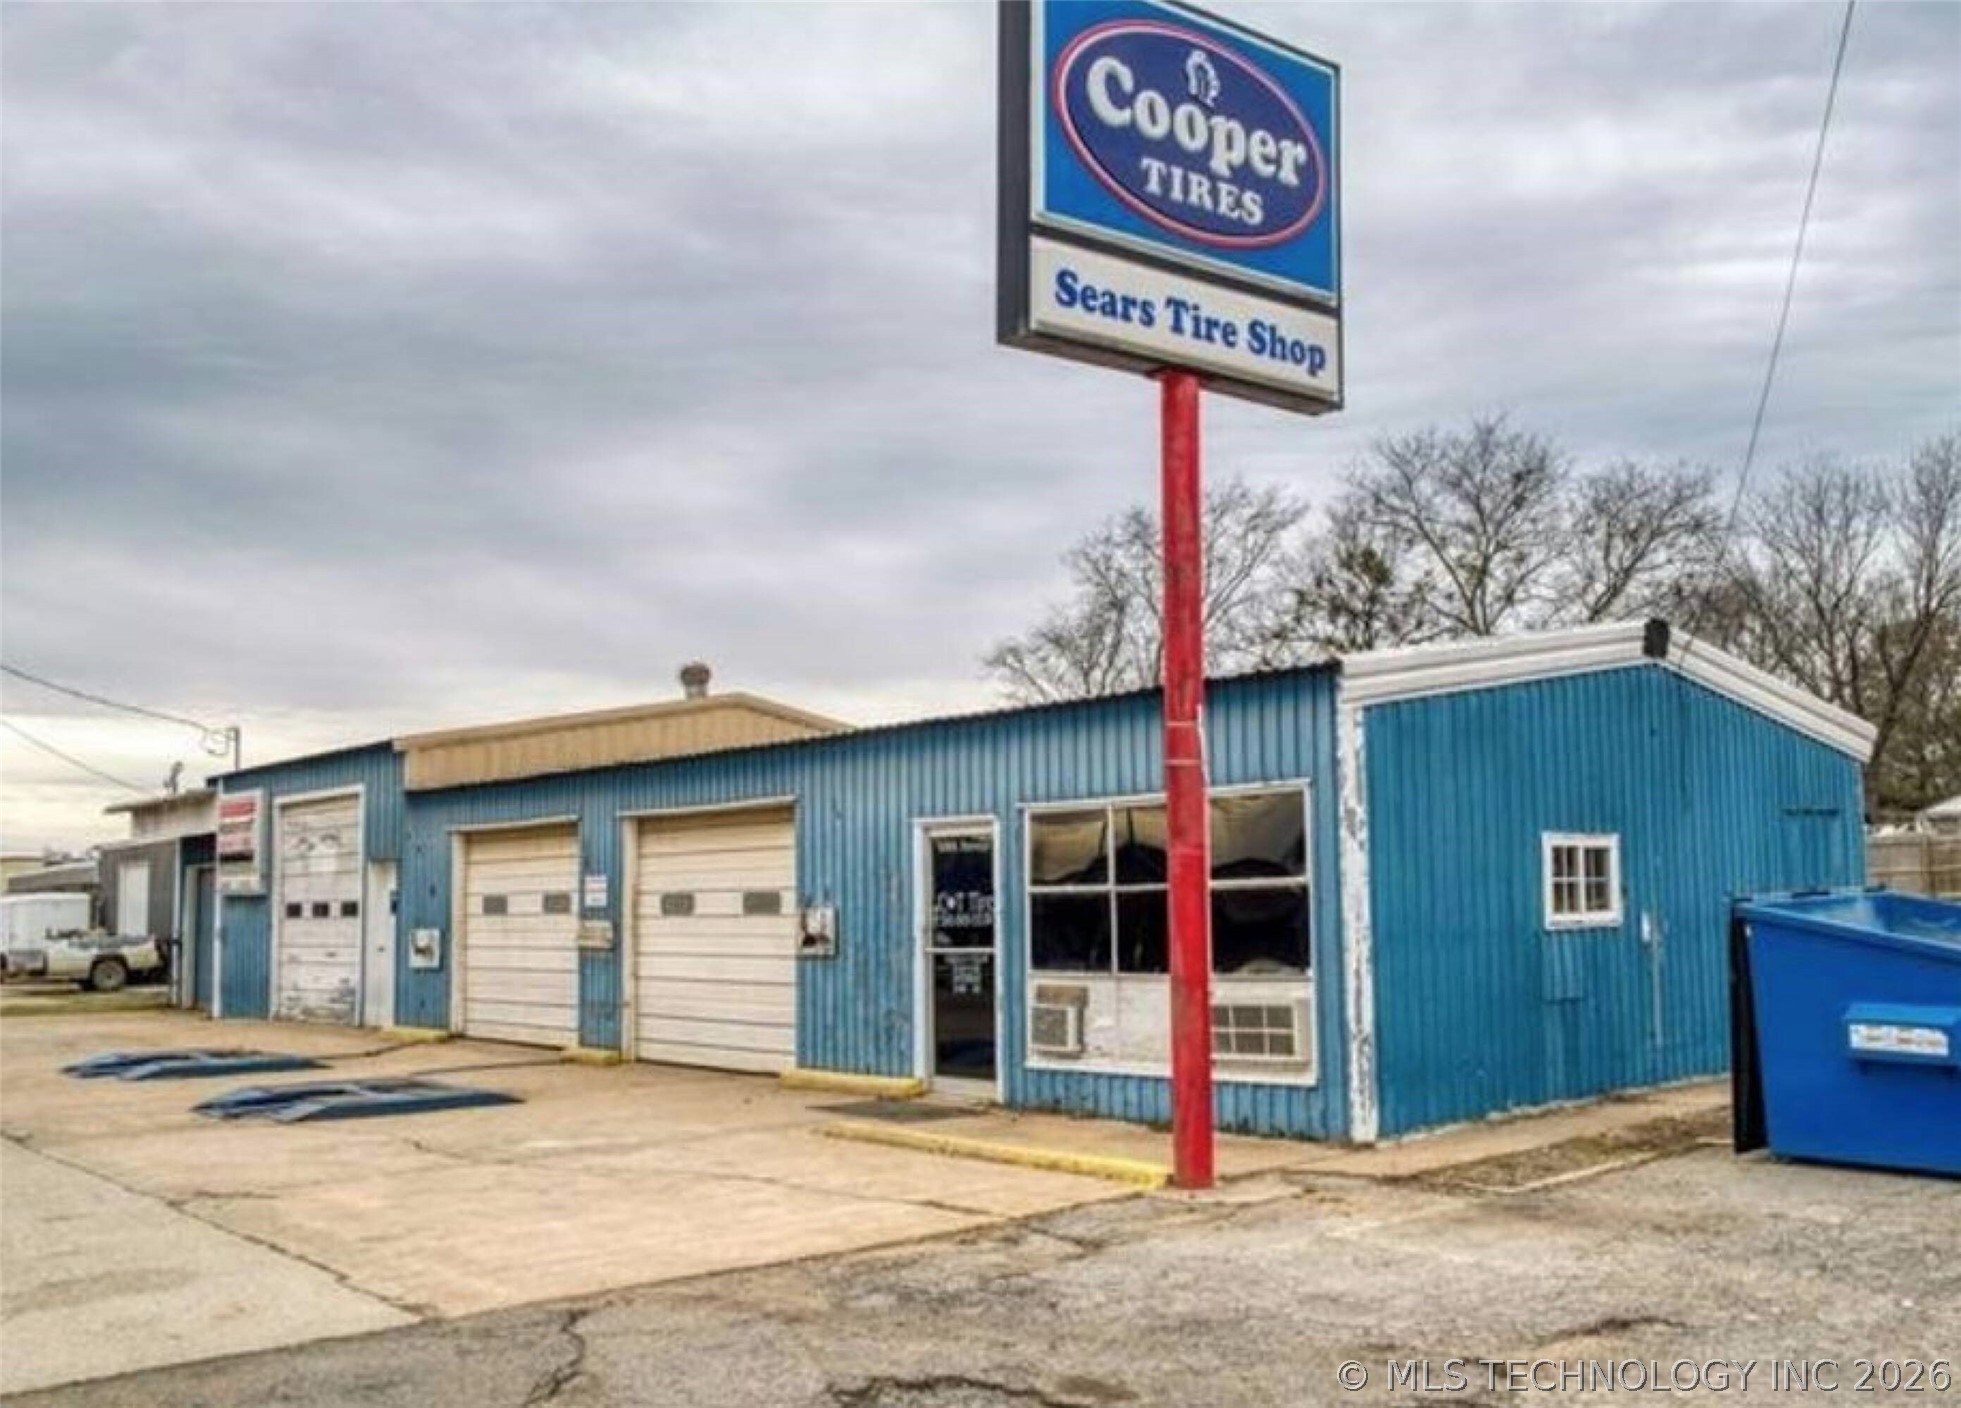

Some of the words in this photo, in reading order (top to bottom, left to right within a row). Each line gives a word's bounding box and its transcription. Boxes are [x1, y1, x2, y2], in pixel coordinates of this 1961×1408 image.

[1086, 56, 1307, 187] Cooper
[1140, 157, 1264, 226] TIRES
[1055, 269, 1156, 326] Sears
[1165, 296, 1238, 347] Tire
[1248, 321, 1326, 375] Shop
